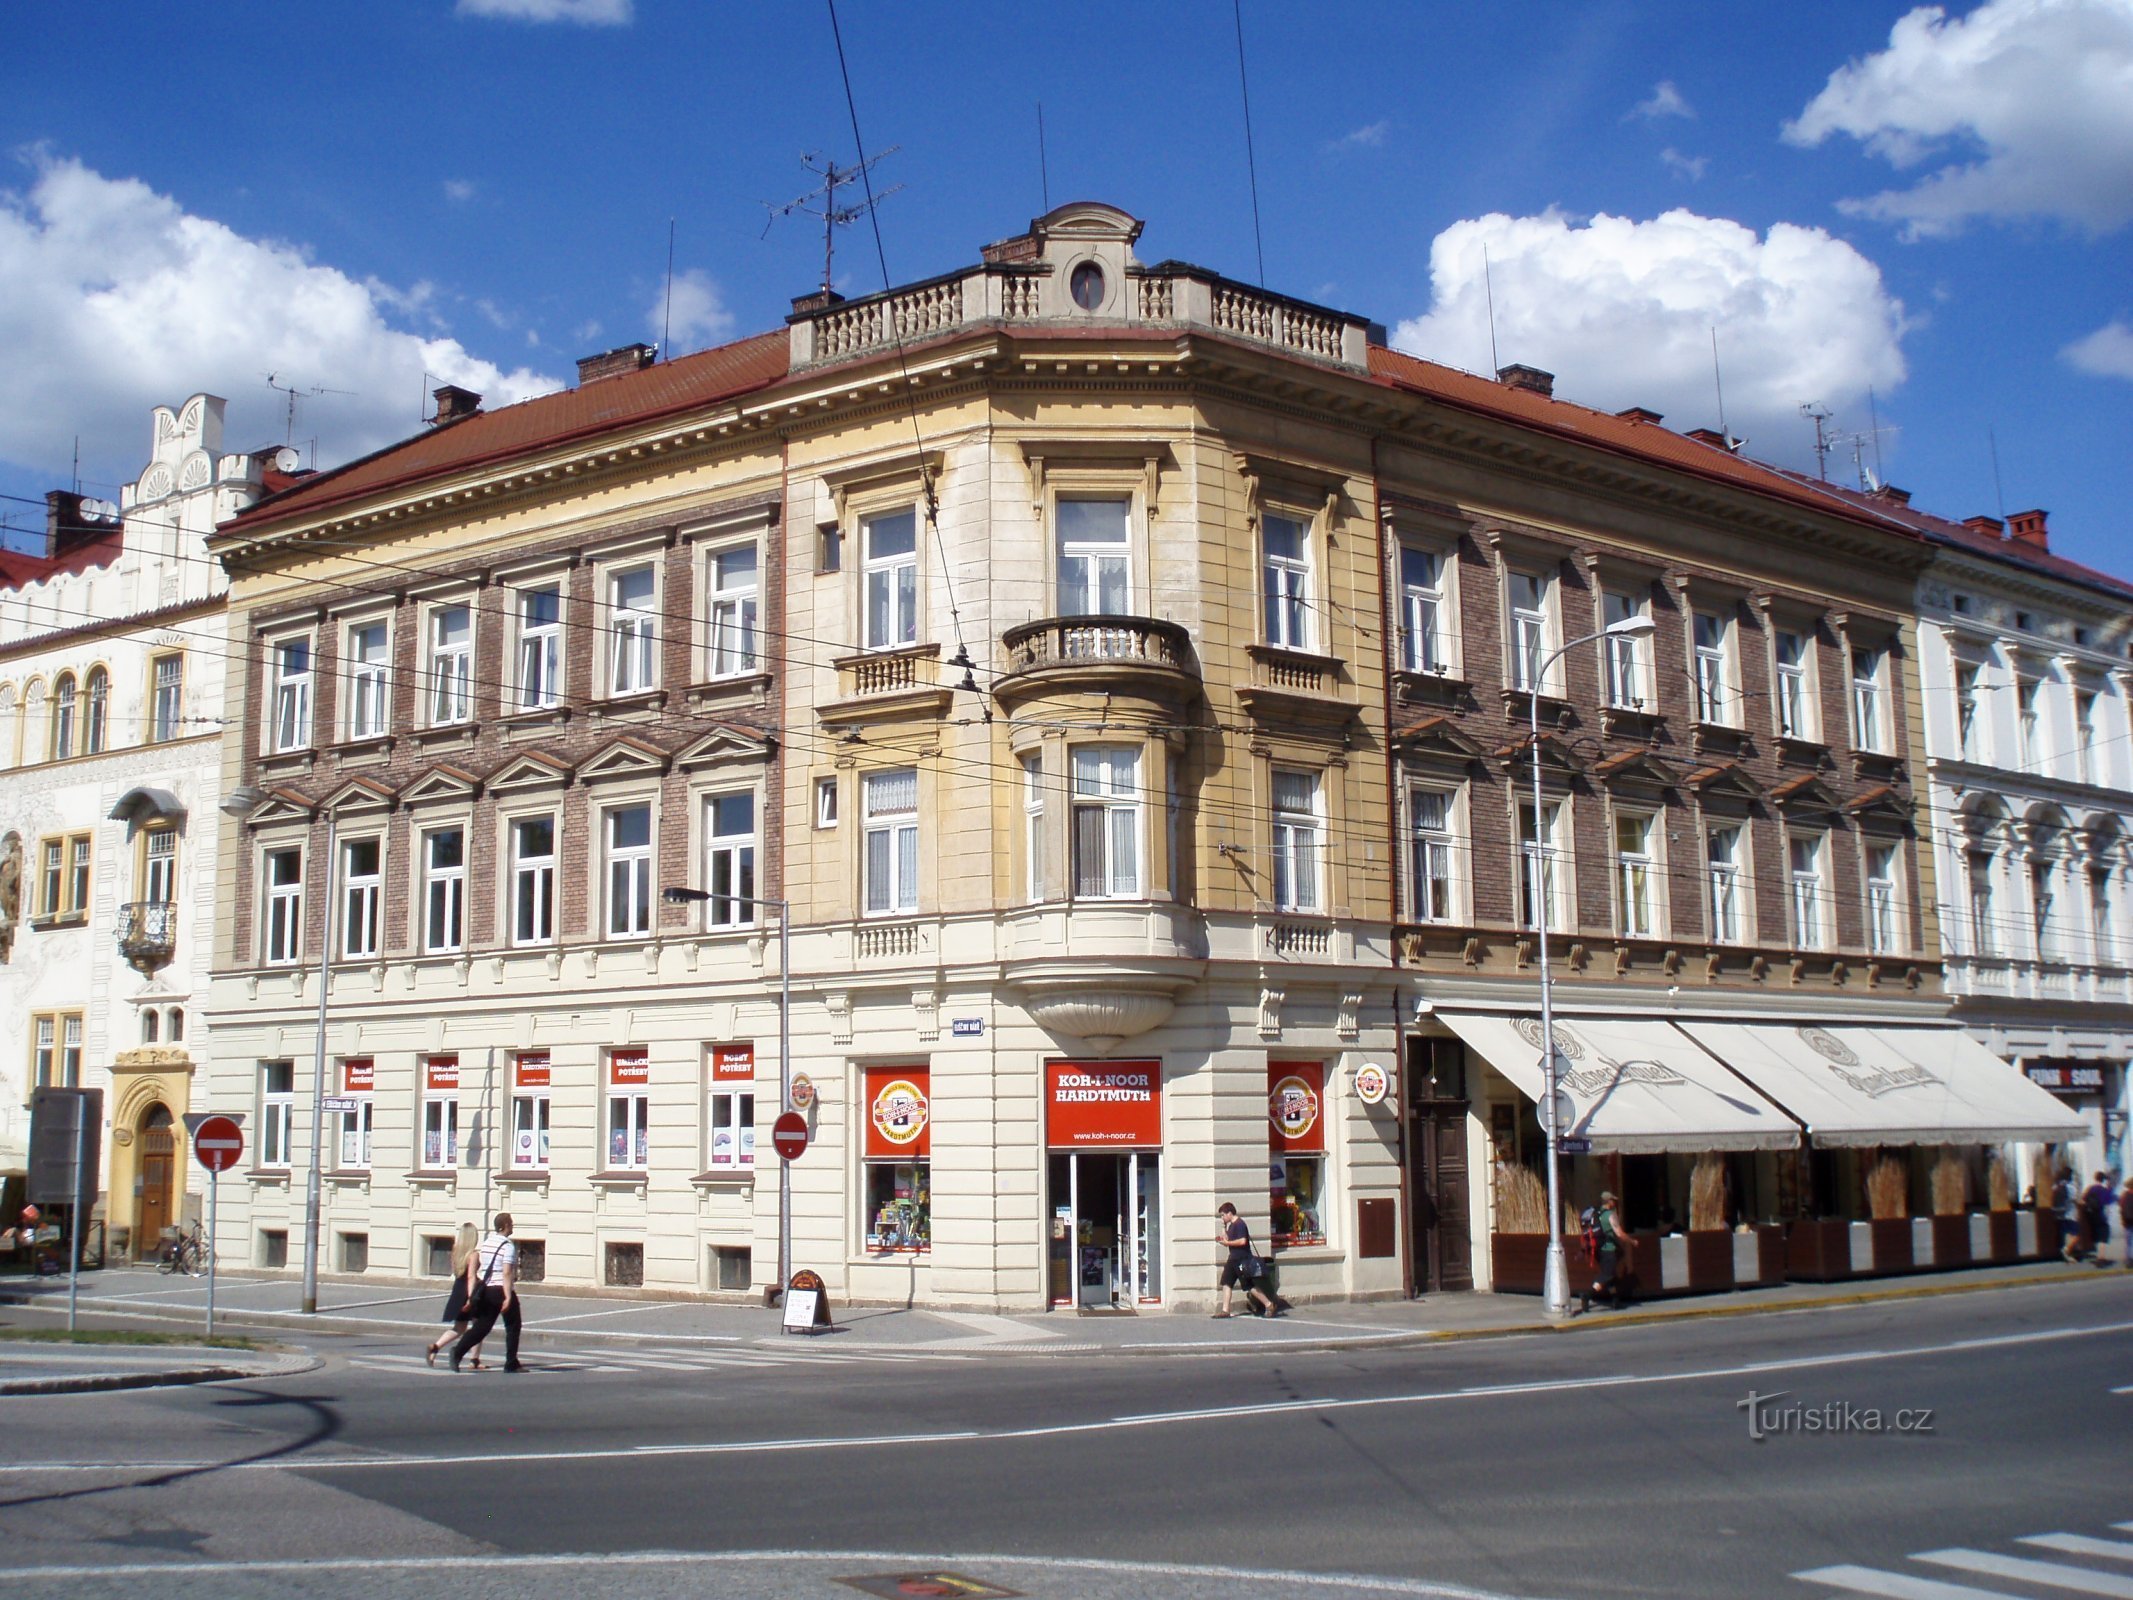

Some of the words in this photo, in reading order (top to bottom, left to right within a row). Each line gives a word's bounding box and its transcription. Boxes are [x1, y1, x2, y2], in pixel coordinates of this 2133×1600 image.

[720, 1063, 752, 1073] POTŘEBY
[1058, 1074, 1149, 1087] KOH-I-NOOR
[2071, 1069, 2104, 1086] SOUL
[1056, 1089, 1151, 1102] HARDTMUTH
